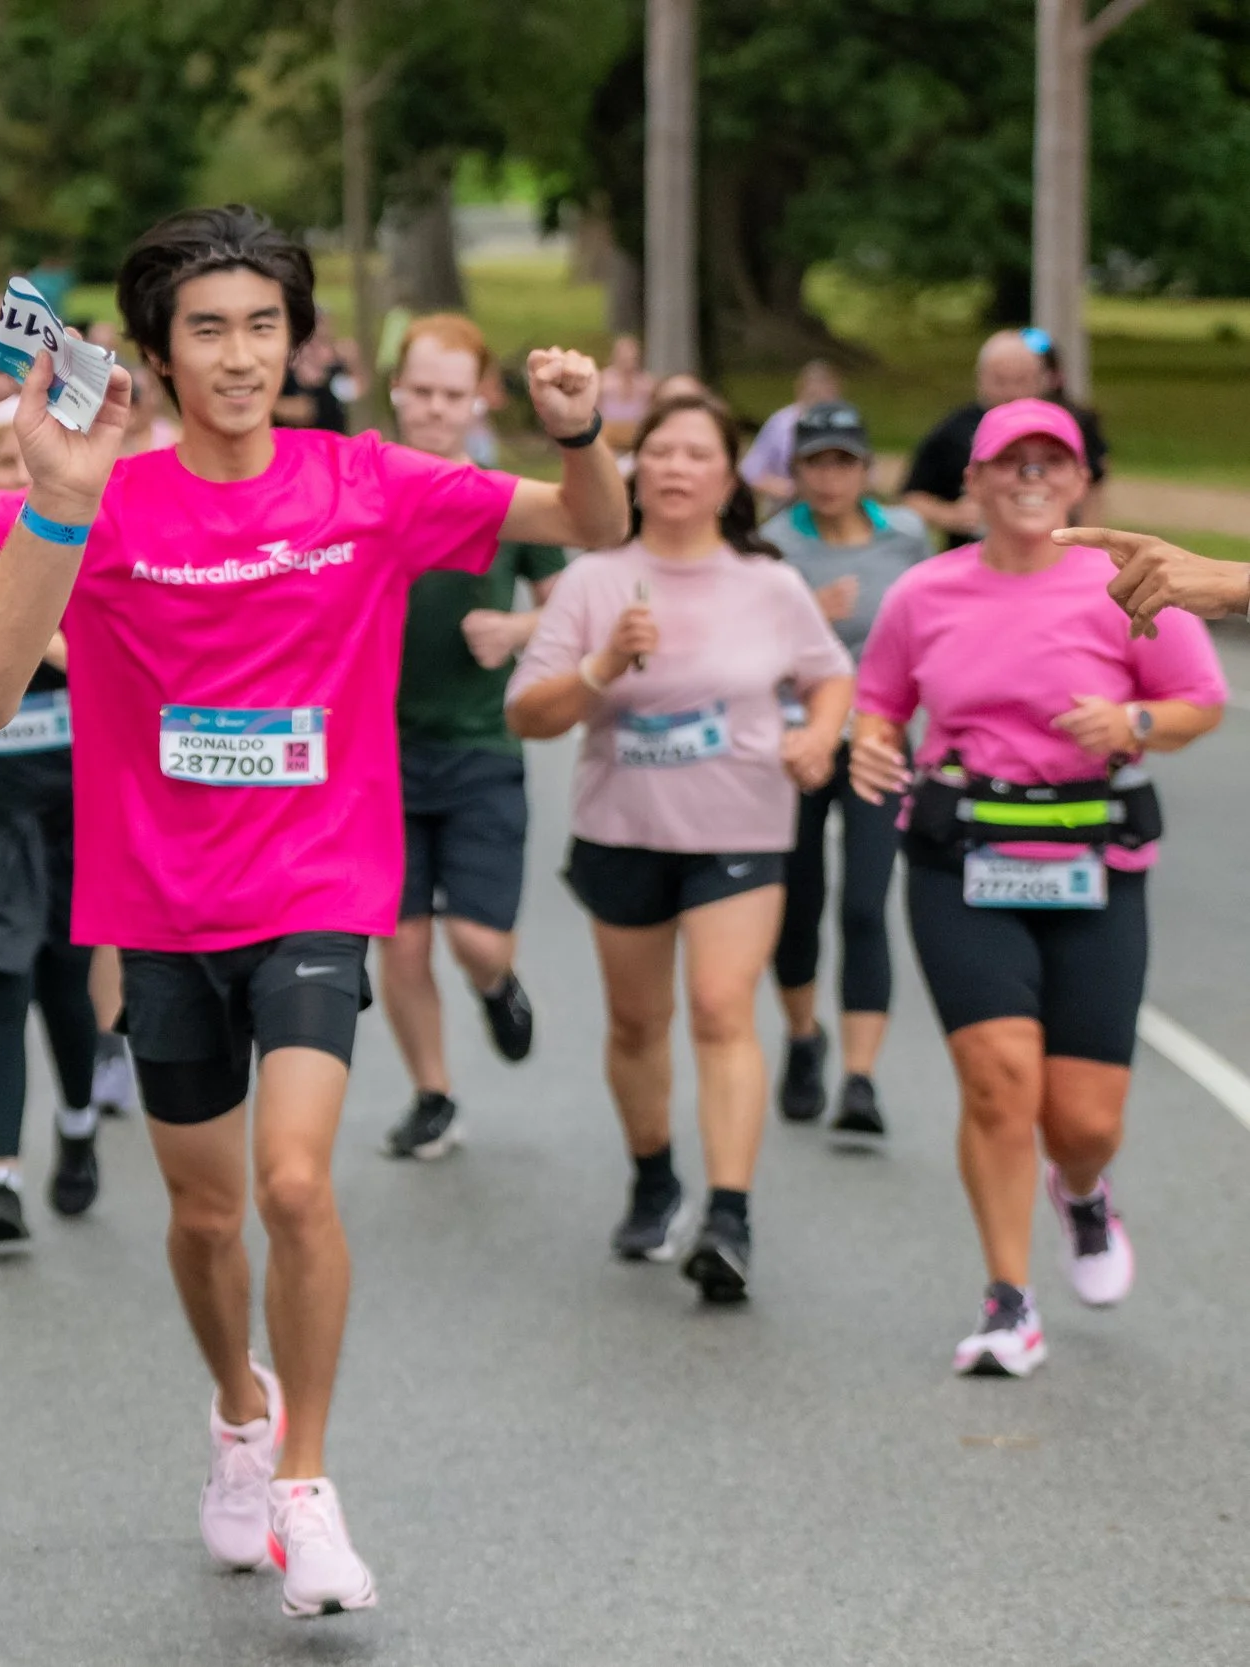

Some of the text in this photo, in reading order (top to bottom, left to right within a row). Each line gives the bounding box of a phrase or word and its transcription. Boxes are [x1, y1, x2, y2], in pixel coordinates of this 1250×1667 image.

[131, 540, 356, 585] AustralianSuper
[178, 736, 264, 752] RONALDO
[287, 743, 307, 757] 12
[169, 753, 274, 777] 287700
[286, 761, 305, 770] KM
